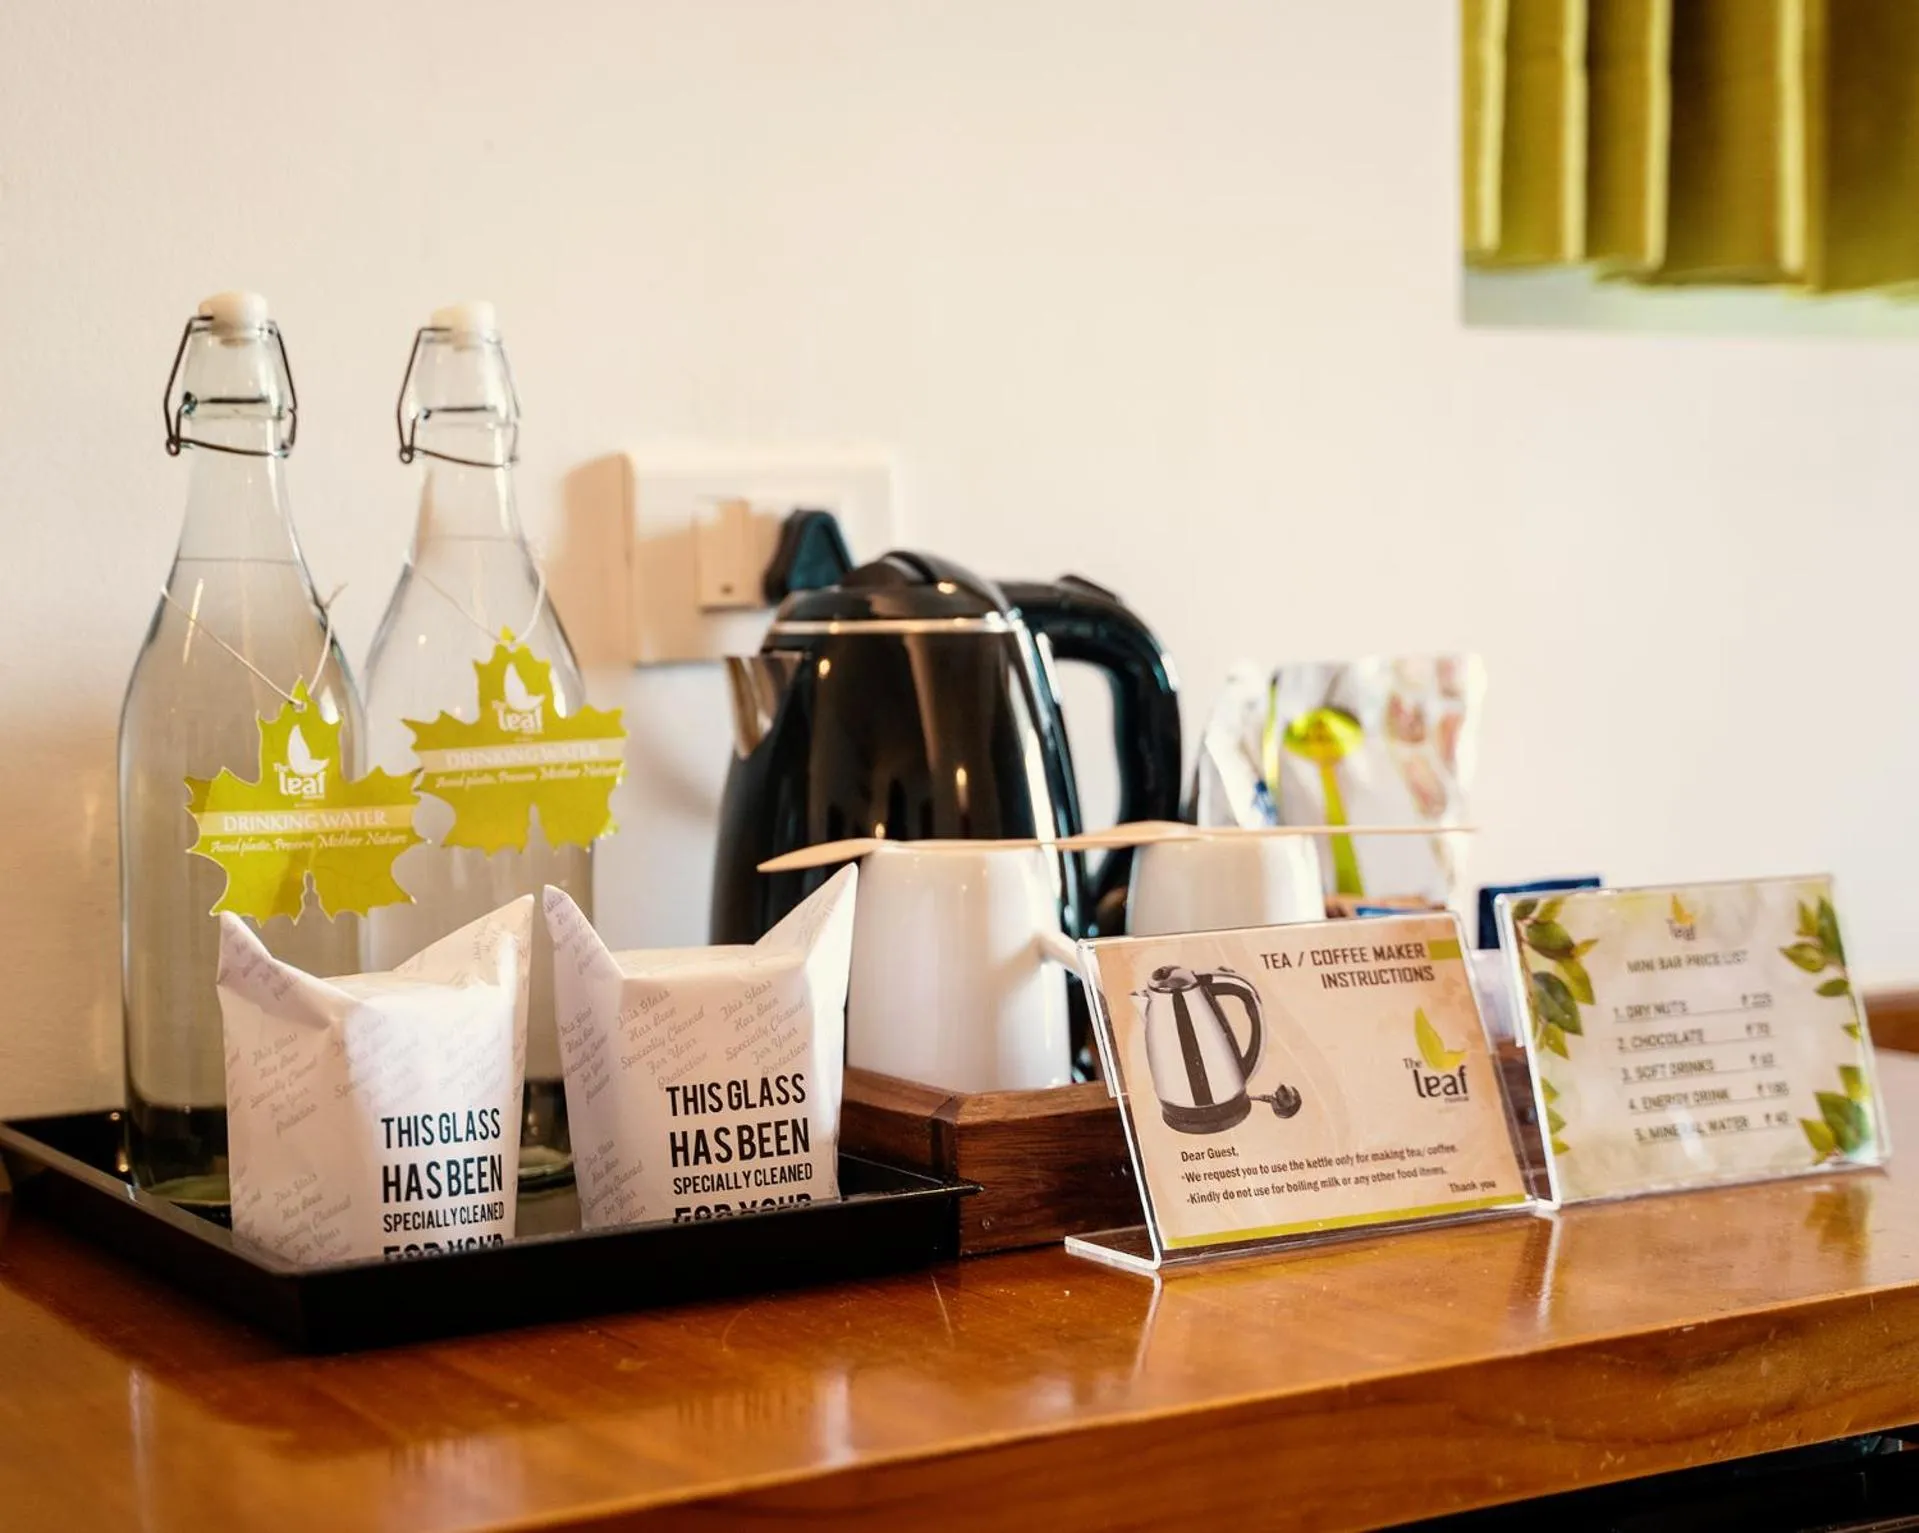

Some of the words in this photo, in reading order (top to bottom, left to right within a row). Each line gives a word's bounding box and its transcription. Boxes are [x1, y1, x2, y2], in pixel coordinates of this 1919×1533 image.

[497, 704, 543, 733] leaf
[445, 749, 538, 769] DRINKING
[539, 745, 599, 763] WATER
[279, 770, 326, 796] leaf
[223, 811, 318, 833] DRINKING
[320, 809, 388, 830] WATER
[318, 832, 363, 848] Mother
[1260, 952, 1293, 970] TEA
[1297, 951, 1305, 968] /
[1310, 947, 1369, 967] COFFEE
[1372, 942, 1427, 962] MAKER
[1321, 964, 1435, 990] INSTRUCTIONS
[1631, 1028, 1704, 1049] CHOCOLATE
[1402, 1057, 1422, 1070] The
[666, 1081, 723, 1117] THIS
[727, 1073, 806, 1111] GLASS
[1413, 1064, 1468, 1098] leaf
[381, 1114, 435, 1149] THIS
[438, 1108, 501, 1144] GLASS
[670, 1125, 733, 1168] HAS
[736, 1117, 811, 1161] BEEN
[1648, 1120, 1705, 1139] MINEL
[1180, 1150, 1205, 1163] Dear
[1203, 1167, 1242, 1183] request
[1241, 1167, 1259, 1180] you
[1259, 1163, 1270, 1175] to
[1271, 1163, 1288, 1173] use
[1289, 1159, 1305, 1171] the
[1305, 1155, 1333, 1169] kettle
[1335, 1154, 1354, 1167] only
[1355, 1152, 1369, 1164] for
[1371, 1149, 1405, 1162] making
[382, 1160, 443, 1203] HAS
[446, 1154, 503, 1197] BEEN
[673, 1170, 751, 1195] SPECIALLY
[754, 1162, 813, 1187] CLEANED
[1222, 1188, 1235, 1200] do
[1236, 1186, 1253, 1198] not
[1253, 1187, 1270, 1197] use
[1271, 1183, 1285, 1194] for
[1286, 1179, 1320, 1193] boiling
[1320, 1175, 1340, 1188] milk
[1342, 1177, 1351, 1186] or
[1353, 1175, 1370, 1186] any
[1371, 1170, 1395, 1183] other
[1397, 1167, 1418, 1179] food
[1448, 1179, 1477, 1193] Thank
[1479, 1179, 1497, 1191] you
[383, 1207, 458, 1233] SPECIALLY
[459, 1201, 505, 1225] CLEANED
